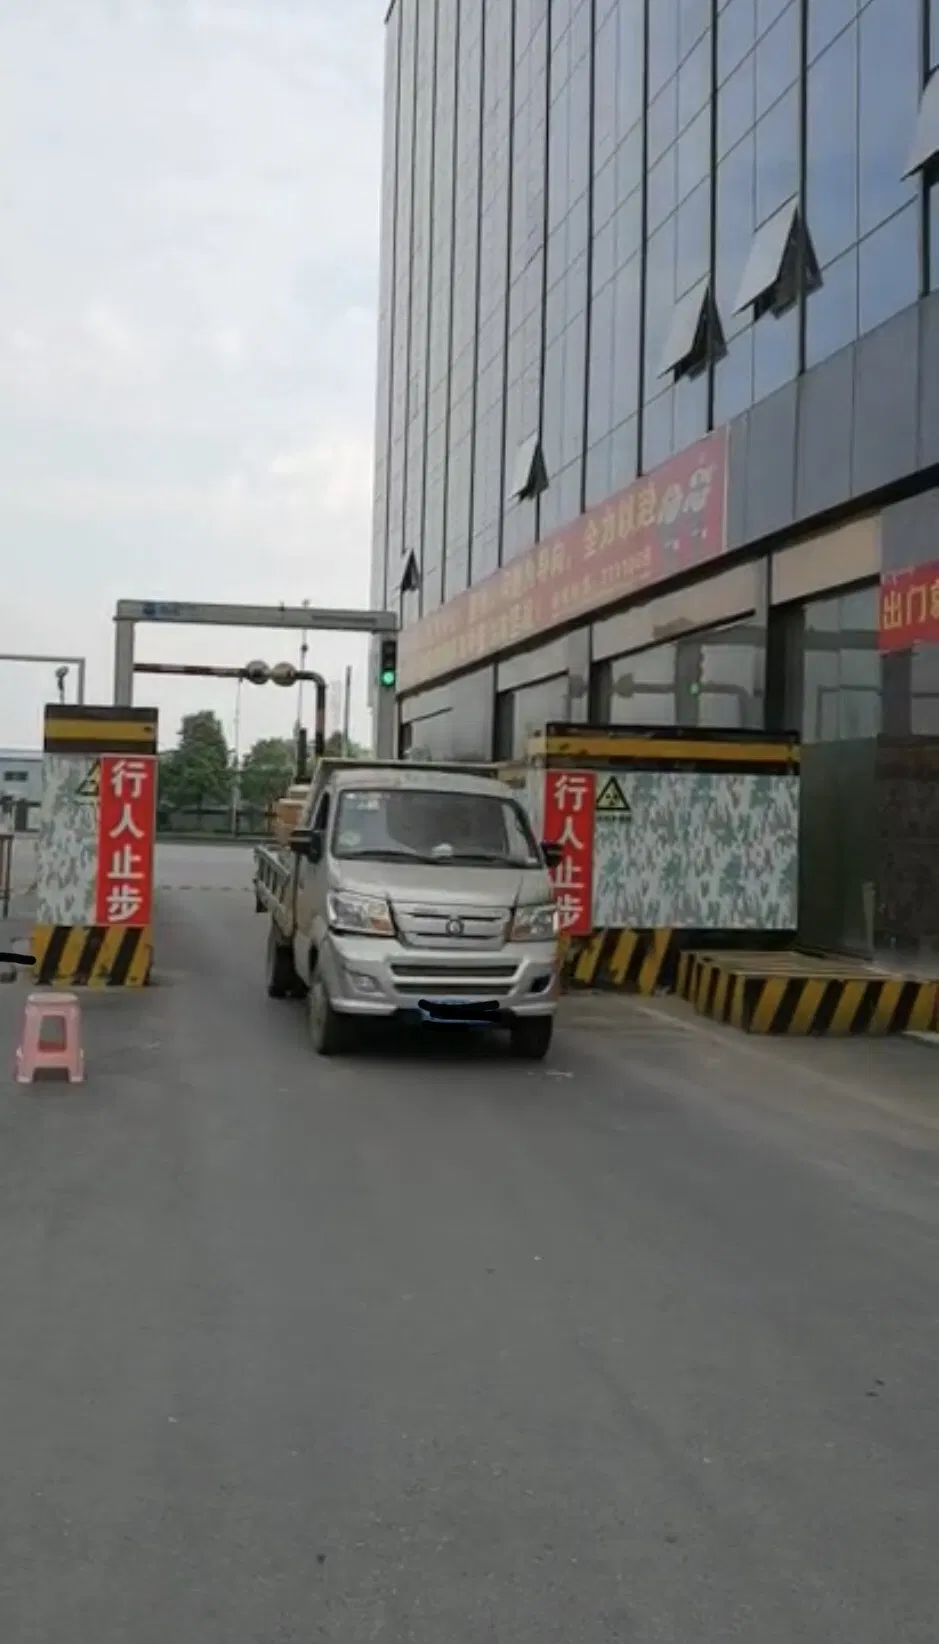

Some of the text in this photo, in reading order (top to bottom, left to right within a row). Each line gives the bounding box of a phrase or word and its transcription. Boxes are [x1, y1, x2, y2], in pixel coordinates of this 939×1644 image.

[106, 759, 148, 922] 行人止步
[552, 774, 589, 929] 行人止步
